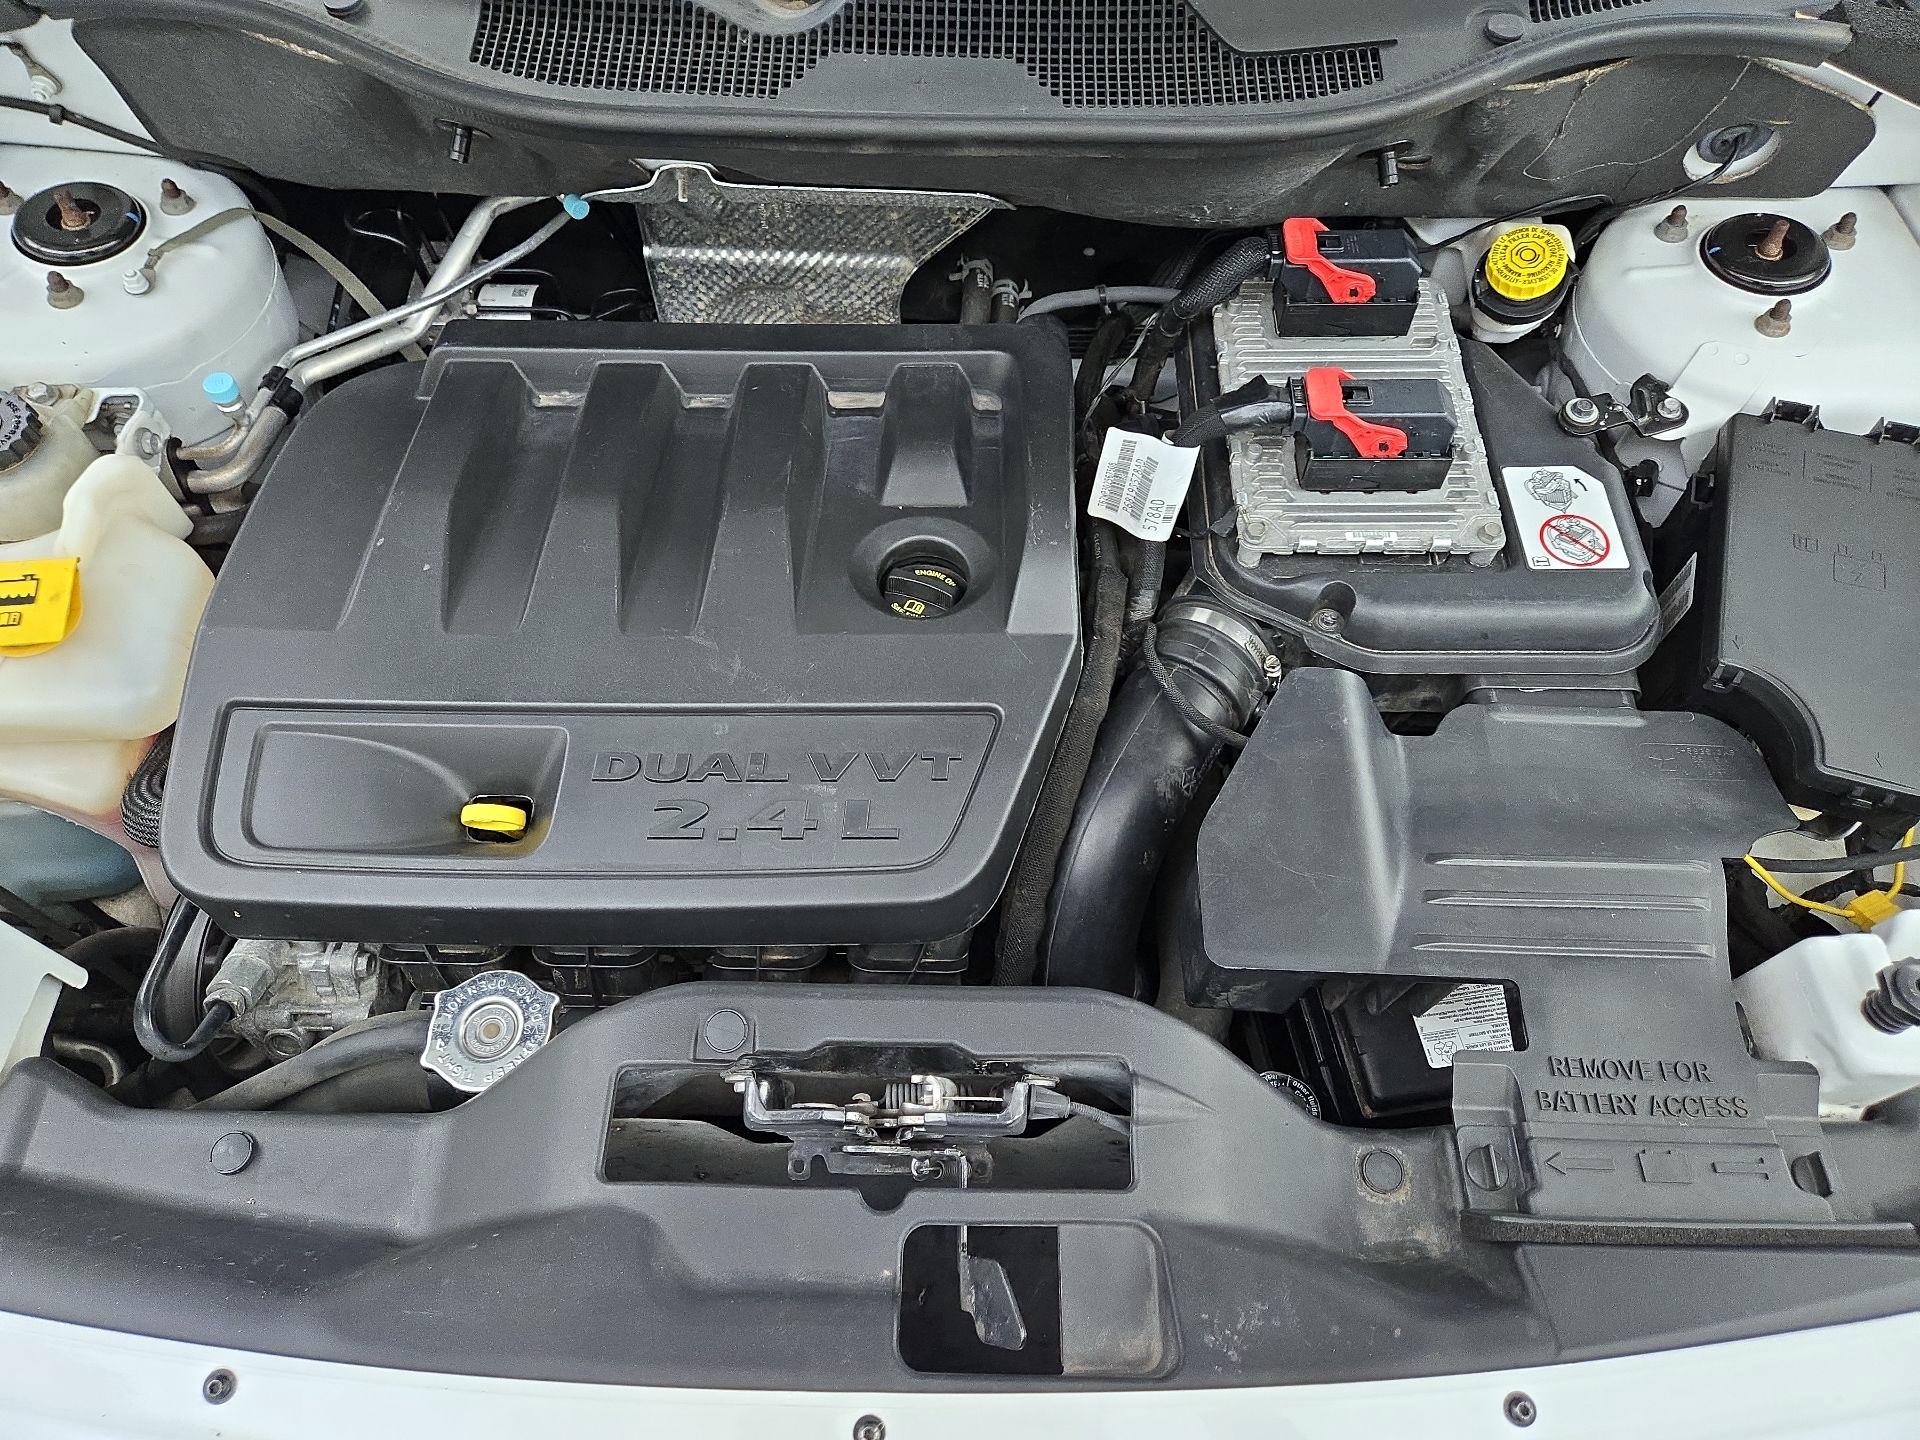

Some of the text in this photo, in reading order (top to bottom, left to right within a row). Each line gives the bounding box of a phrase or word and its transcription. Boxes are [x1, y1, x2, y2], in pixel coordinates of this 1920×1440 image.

[1508, 233, 1530, 244] FILLER
[1142, 499, 1165, 531] 578AD
[914, 570, 946, 581] ENGINE
[591, 751, 962, 783] DUAL VVT
[442, 979, 544, 1022] DO NOT OPEN HOT
[437, 1053, 474, 1083] TIGHT
[1548, 1056, 1714, 1083] REMOVE FOR
[1292, 1080, 1309, 1095] Other
[1536, 1089, 1750, 1118] BATTERY ACCESS
